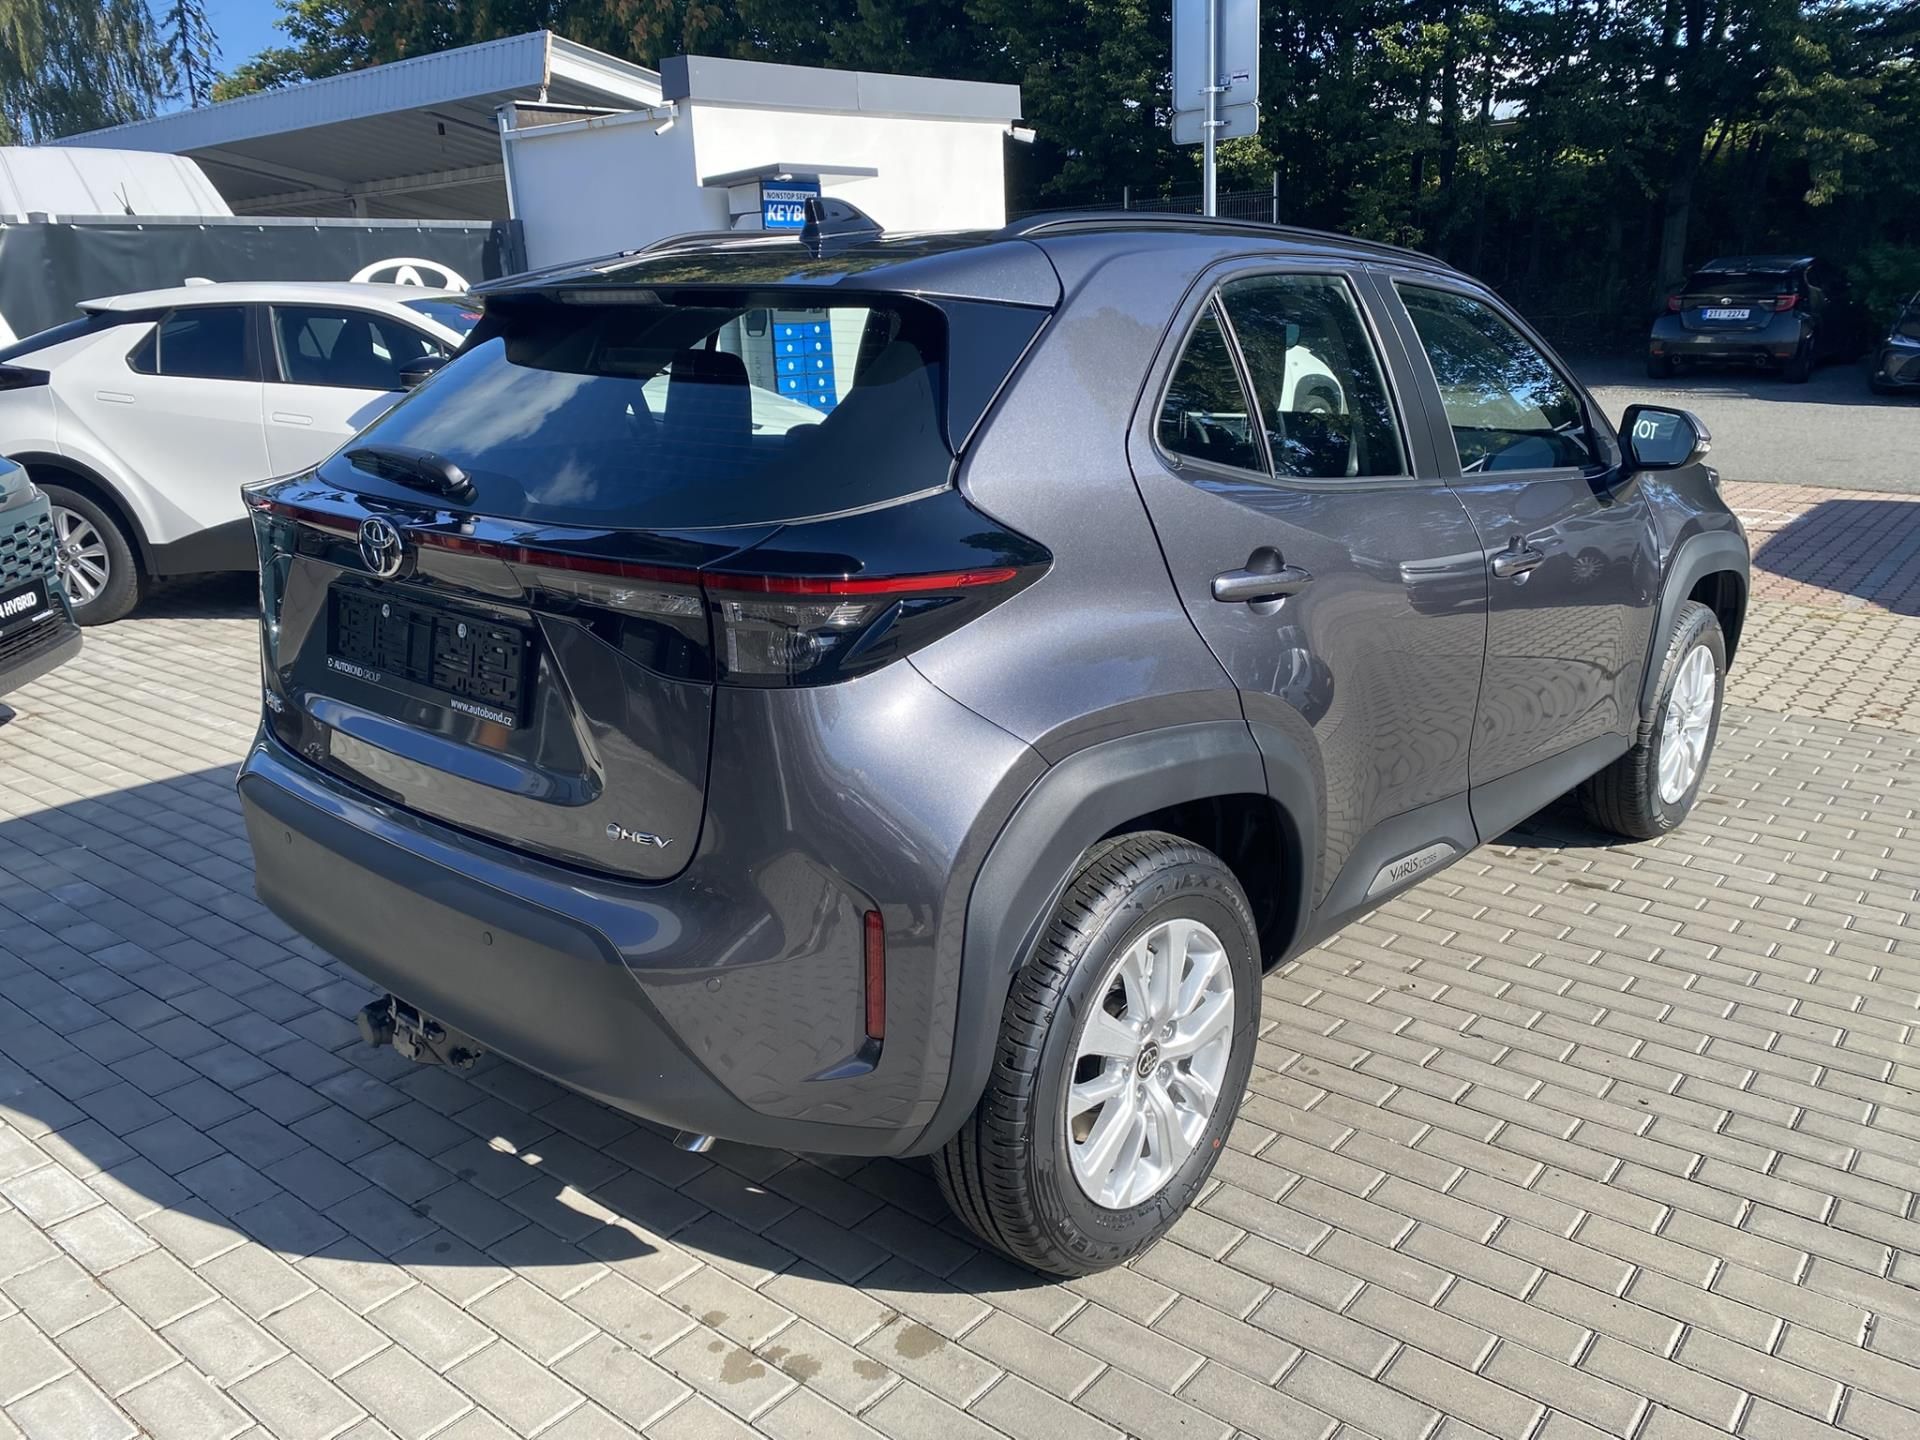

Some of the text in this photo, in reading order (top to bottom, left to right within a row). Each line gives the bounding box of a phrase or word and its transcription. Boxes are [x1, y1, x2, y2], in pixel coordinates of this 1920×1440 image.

[766, 191, 795, 200] NONSTOP
[3, 591, 37, 617] HYBRID
[334, 660, 381, 682] AUTOBOND GROUP
[450, 698, 512, 727] www.autobond.cz
[621, 829, 673, 849] HEV
[1390, 857, 1418, 882] YARIS
